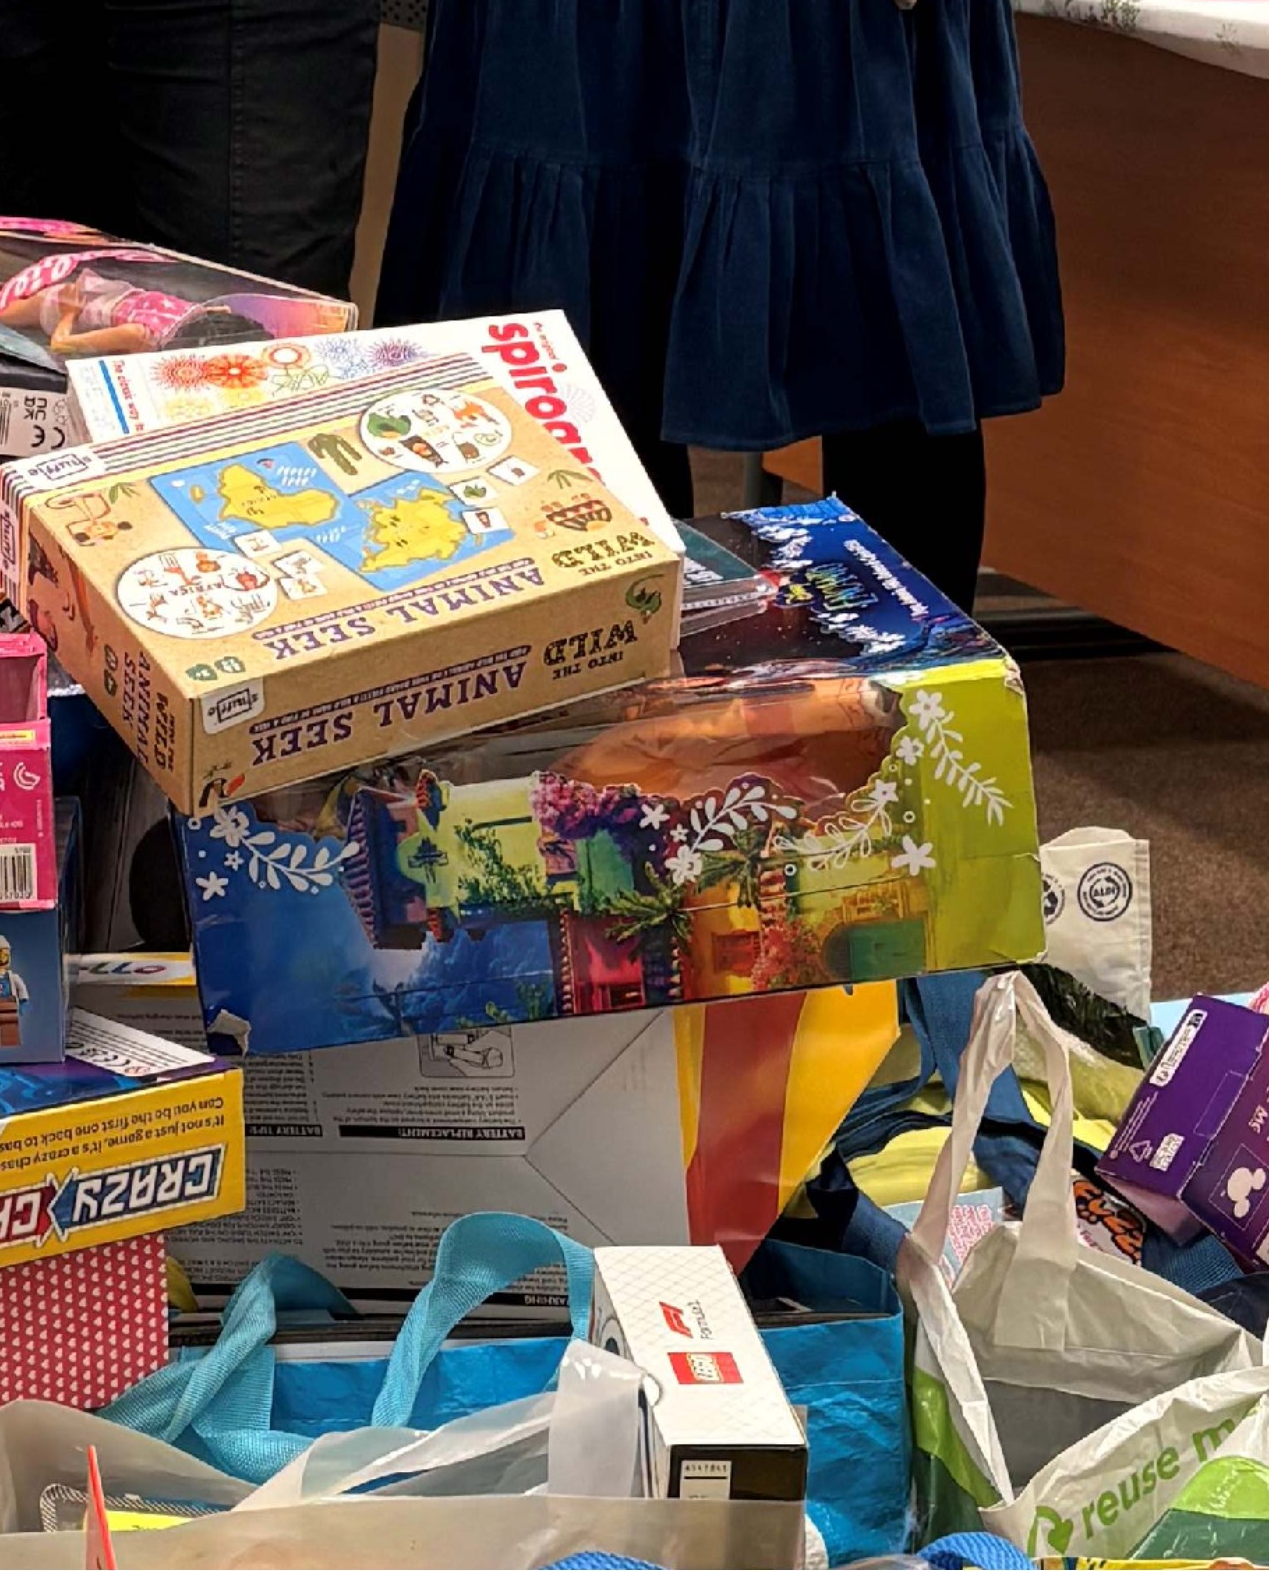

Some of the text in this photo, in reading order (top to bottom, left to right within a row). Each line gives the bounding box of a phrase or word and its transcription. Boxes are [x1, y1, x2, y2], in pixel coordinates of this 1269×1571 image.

[24, 396, 47, 408] CA
[23, 409, 46, 420] UK
[552, 533, 654, 567] WILD
[386, 568, 544, 623] ANIMAL
[264, 617, 375, 659] SEEK
[544, 620, 637, 666] WILD
[553, 651, 623, 680] INTO THE
[123, 652, 135, 728] SEEK
[373, 662, 526, 727] ANIMAL
[137, 651, 150, 764] ANIMAL
[154, 693, 168, 769] WILD
[252, 711, 353, 766] SEEK
[174, 1100, 197, 1116] you
[198, 1097, 223, 1111] Can
[131, 1113, 151, 1126] the
[156, 1109, 171, 1120] be
[205, 1115, 224, 1129] It's
[75, 1124, 99, 1136] one
[101, 1116, 129, 1132] first
[155, 1119, 179, 1137] just
[181, 1119, 203, 1132] not
[277, 1126, 321, 1135] BATTERY
[41, 1130, 72, 1145] back
[104, 1130, 143, 1149] game,
[146, 1129, 152, 1137] a
[477, 1128, 523, 1138] BATTERY
[24, 1137, 38, 1150] to
[72, 1146, 79, 1155] a
[83, 1140, 102, 1154] it's
[33, 1148, 69, 1164] crazy
[72, 1153, 213, 1223] CRAZY
[523, 1294, 569, 1307] ARNING
[1082, 1446, 1180, 1541] reuse
